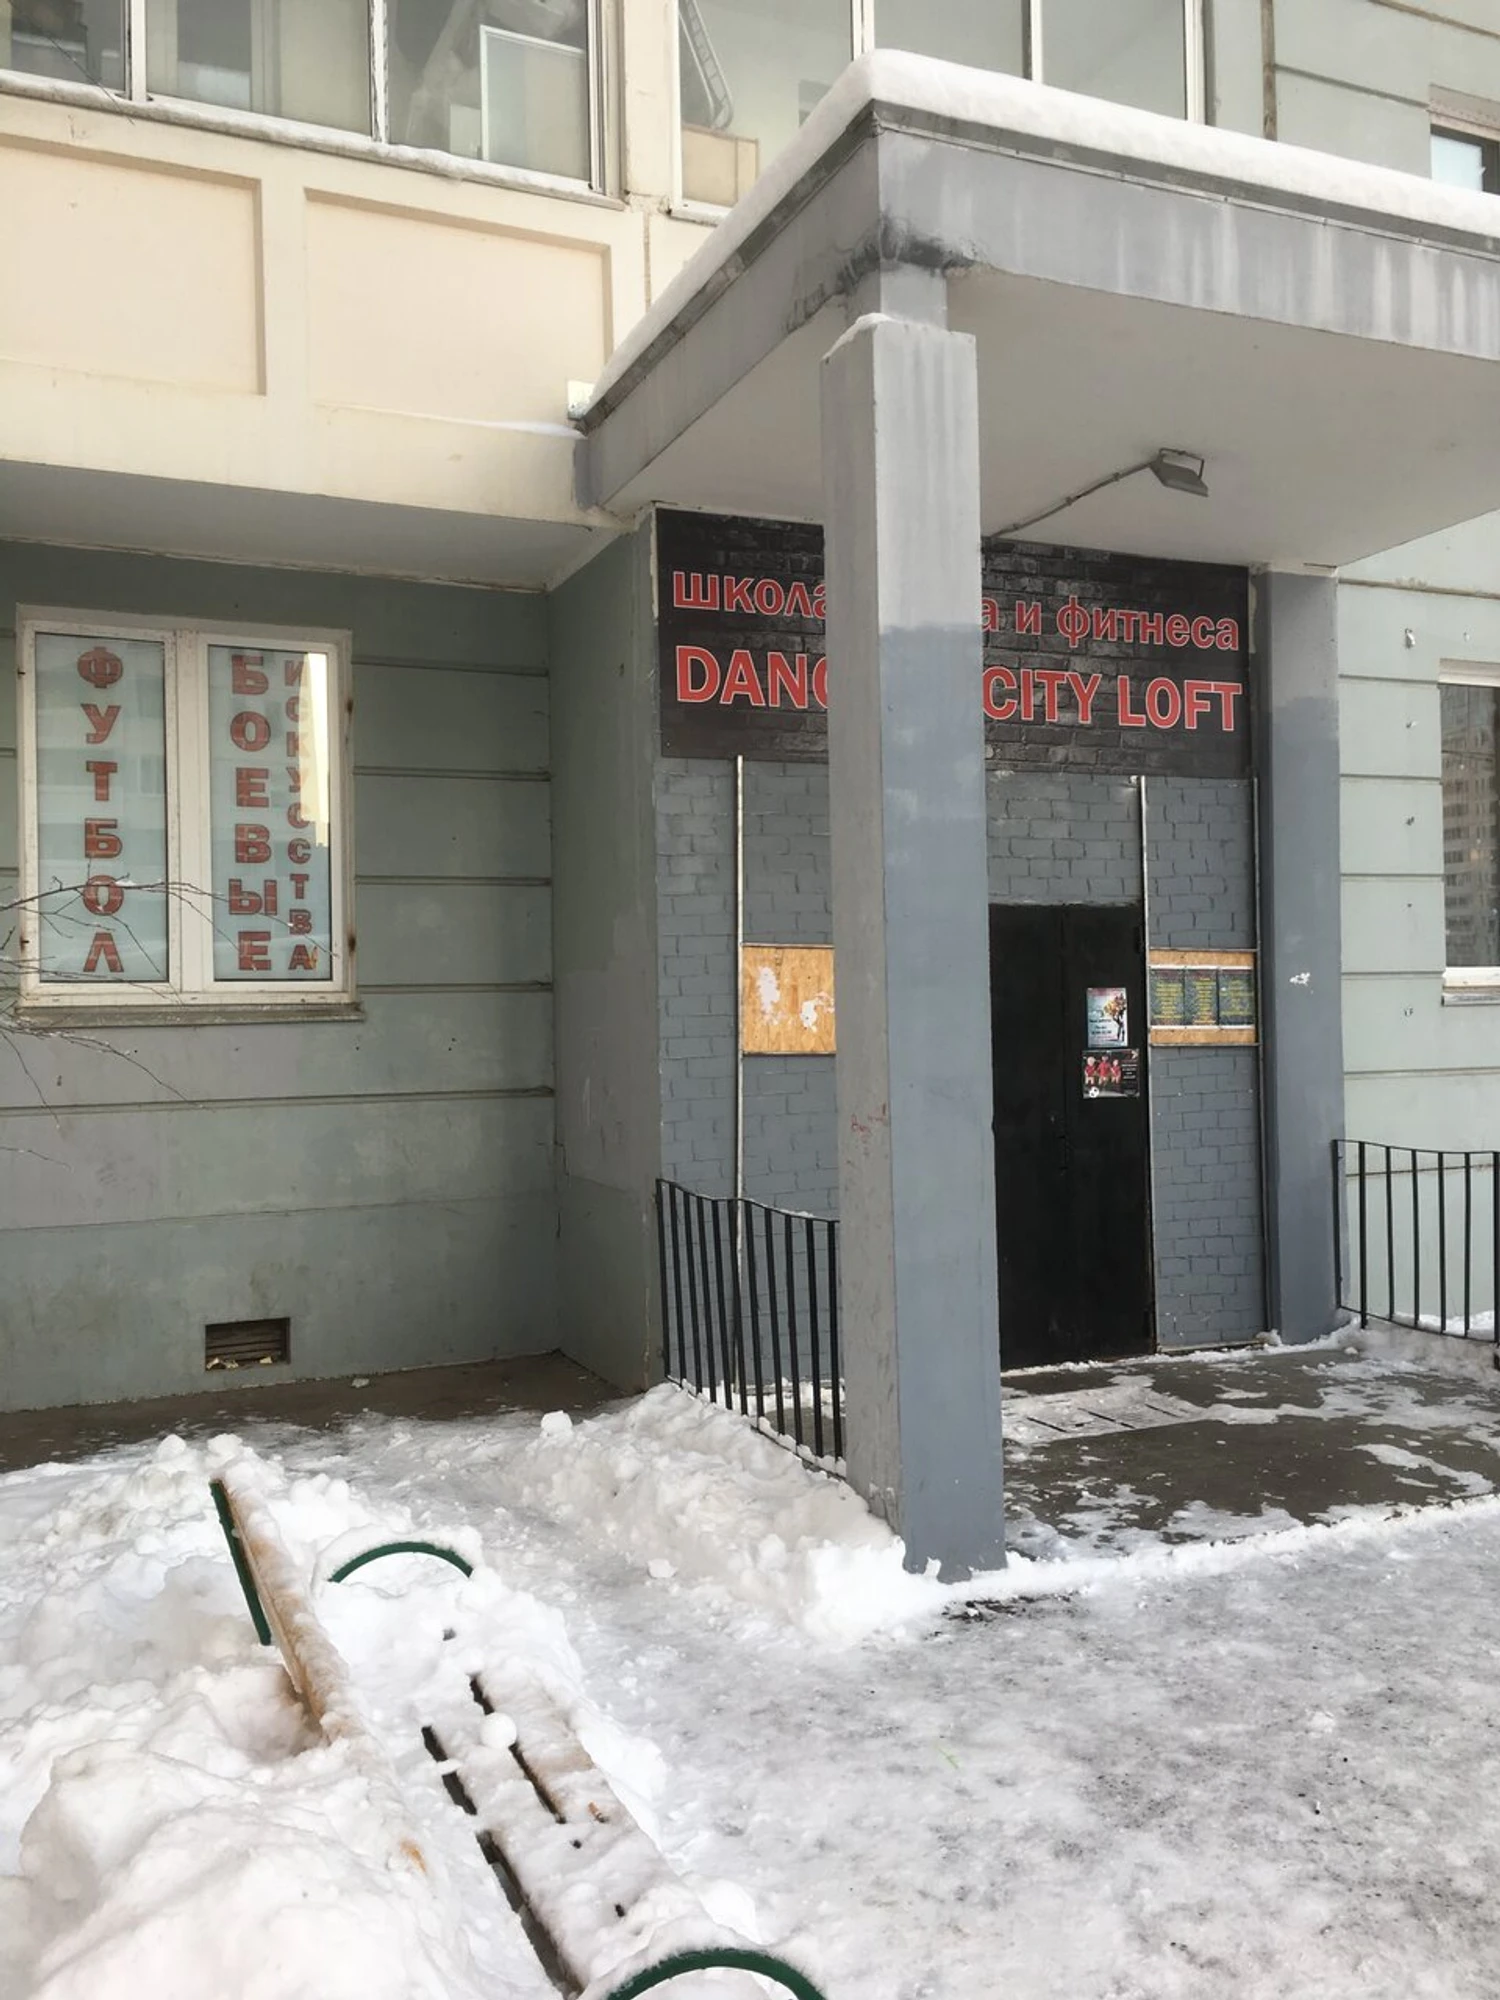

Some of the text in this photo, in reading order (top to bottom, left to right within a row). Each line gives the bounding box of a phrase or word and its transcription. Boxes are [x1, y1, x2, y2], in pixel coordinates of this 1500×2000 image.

[982, 665, 1102, 724] CITY
[1117, 675, 1242, 731] LOFT
[1015, 600, 1041, 635] и
[1056, 595, 1239, 651] фитнеса
[77, 646, 125, 973] ФУТБОЛ
[228, 654, 278, 971] БОЕВЫЕ
